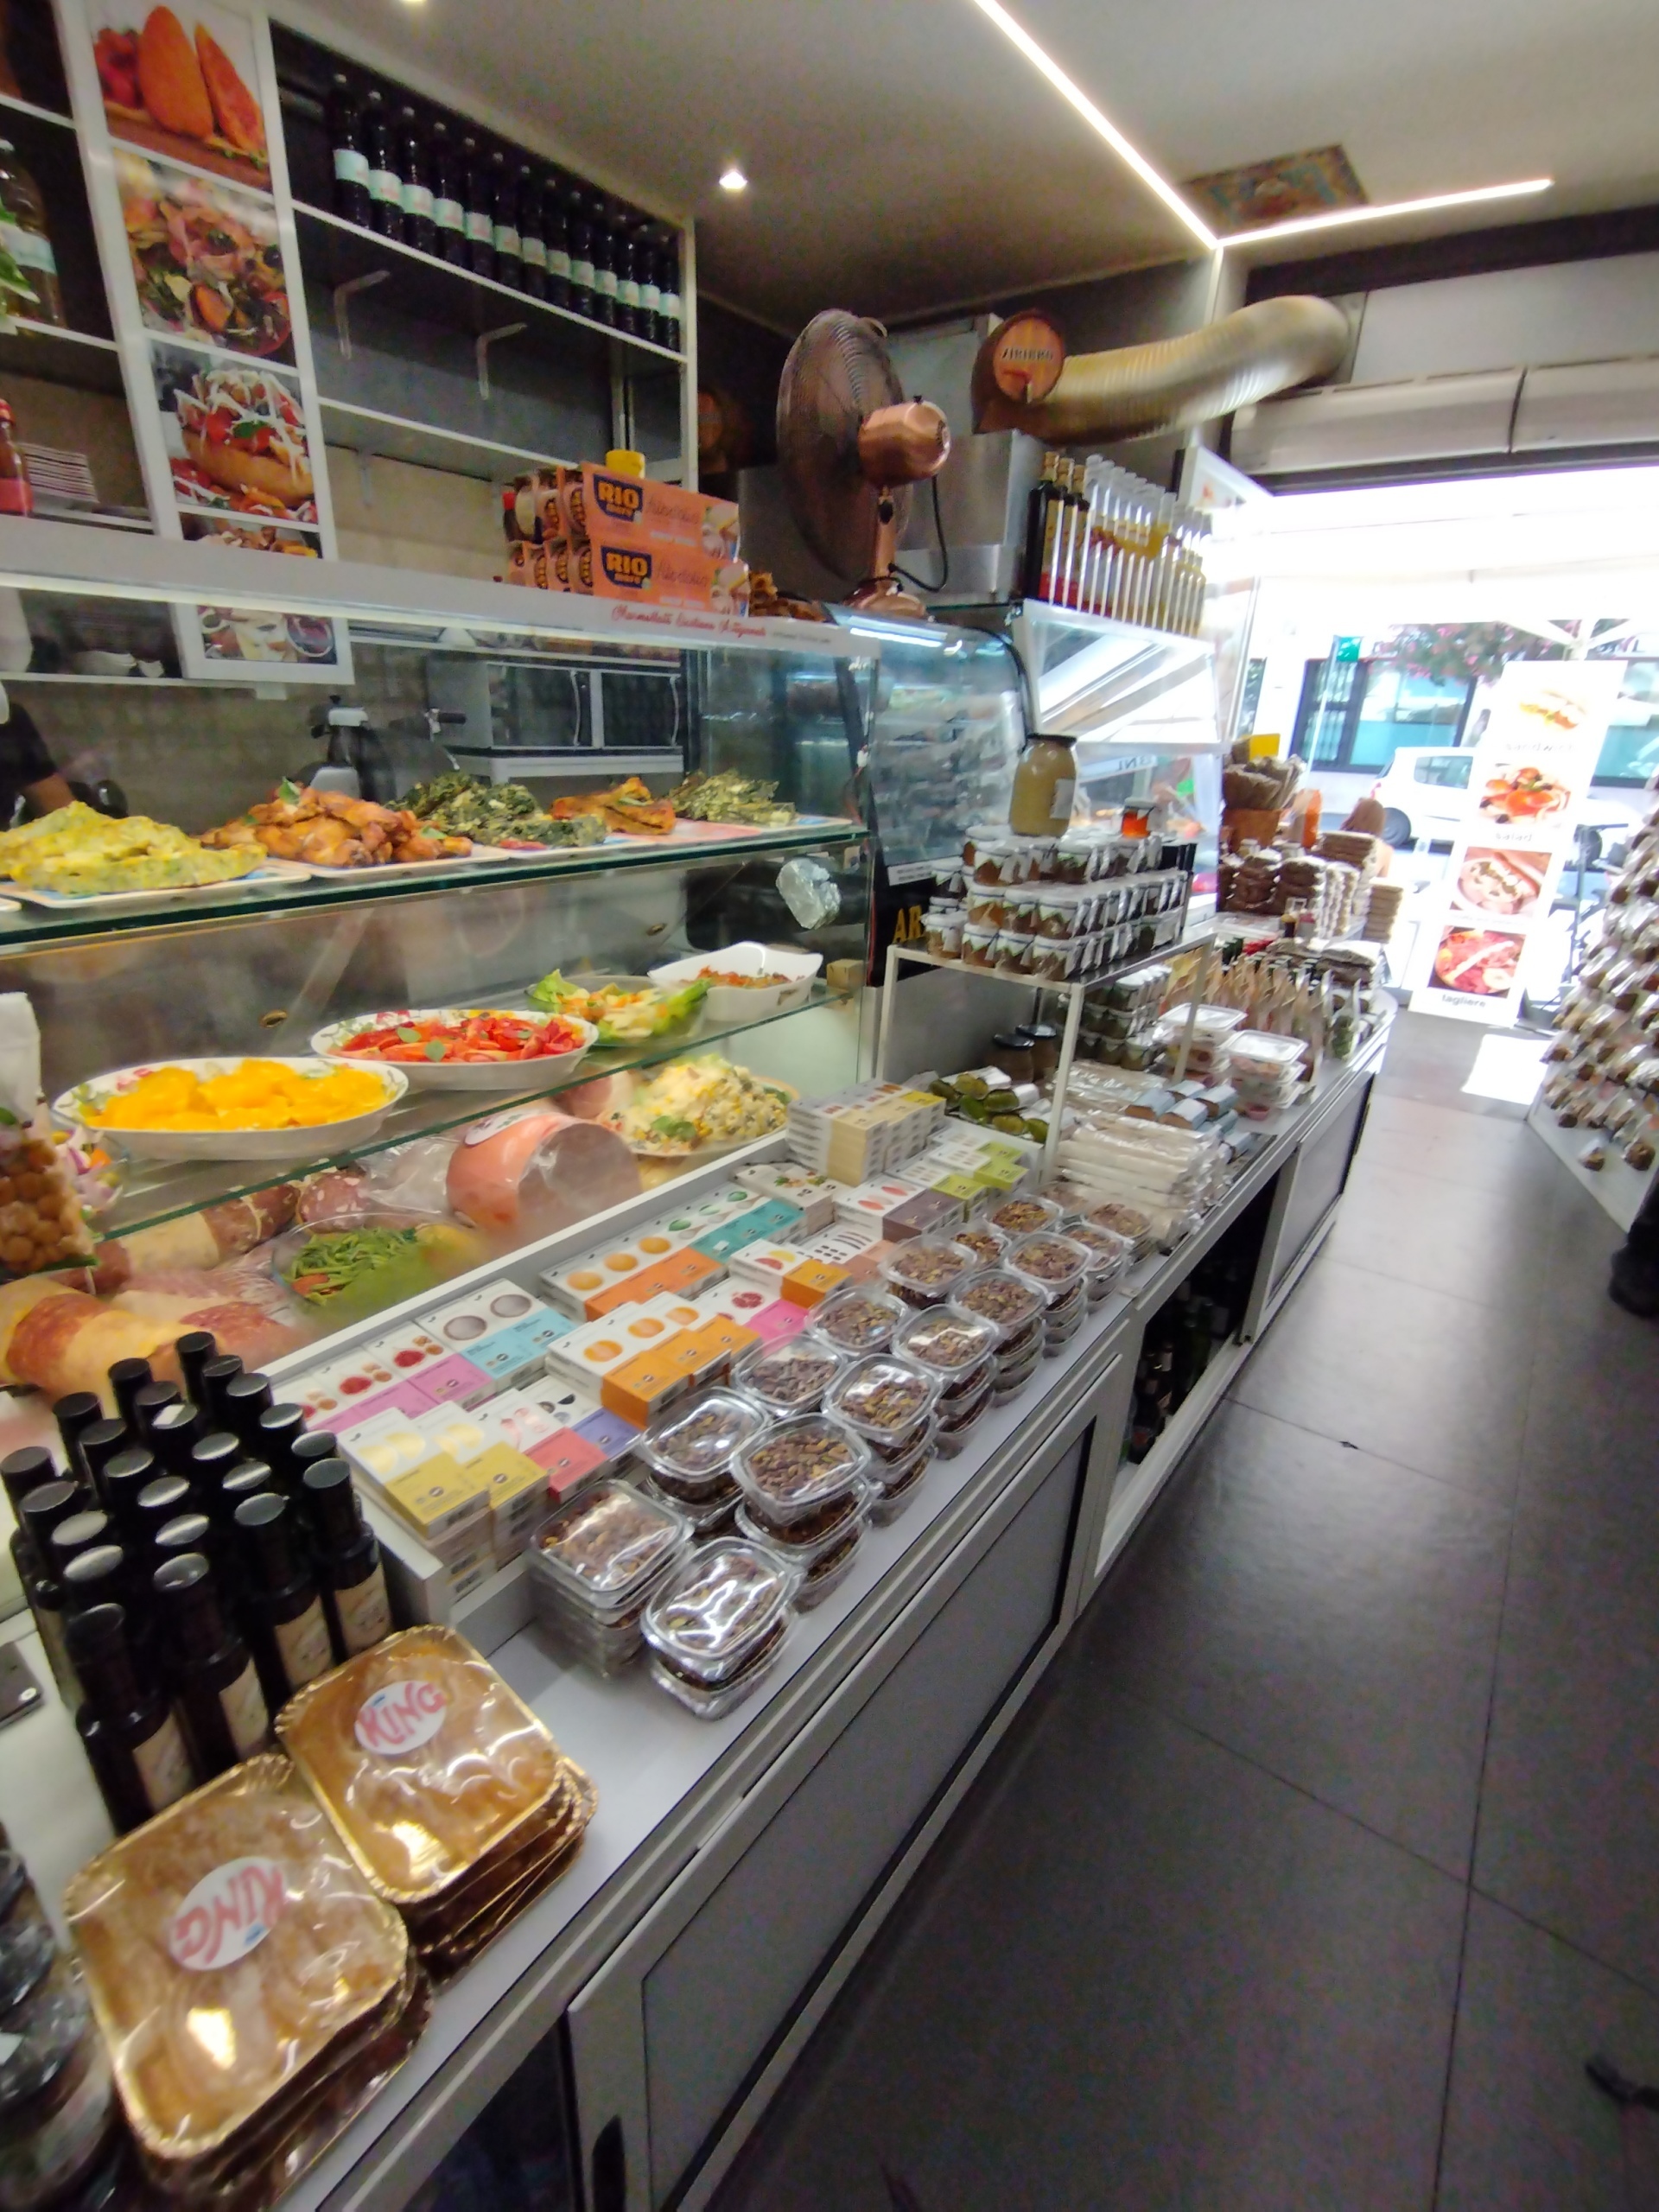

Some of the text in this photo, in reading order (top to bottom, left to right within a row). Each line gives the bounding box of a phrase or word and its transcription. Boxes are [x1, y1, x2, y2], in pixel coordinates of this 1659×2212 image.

[598, 481, 639, 510] RIO
[606, 552, 648, 576] RIO
[1496, 832, 1533, 842] salad
[1441, 994, 1486, 1007] tagliere
[358, 1681, 447, 1747] KING
[175, 1866, 283, 1964] KING
